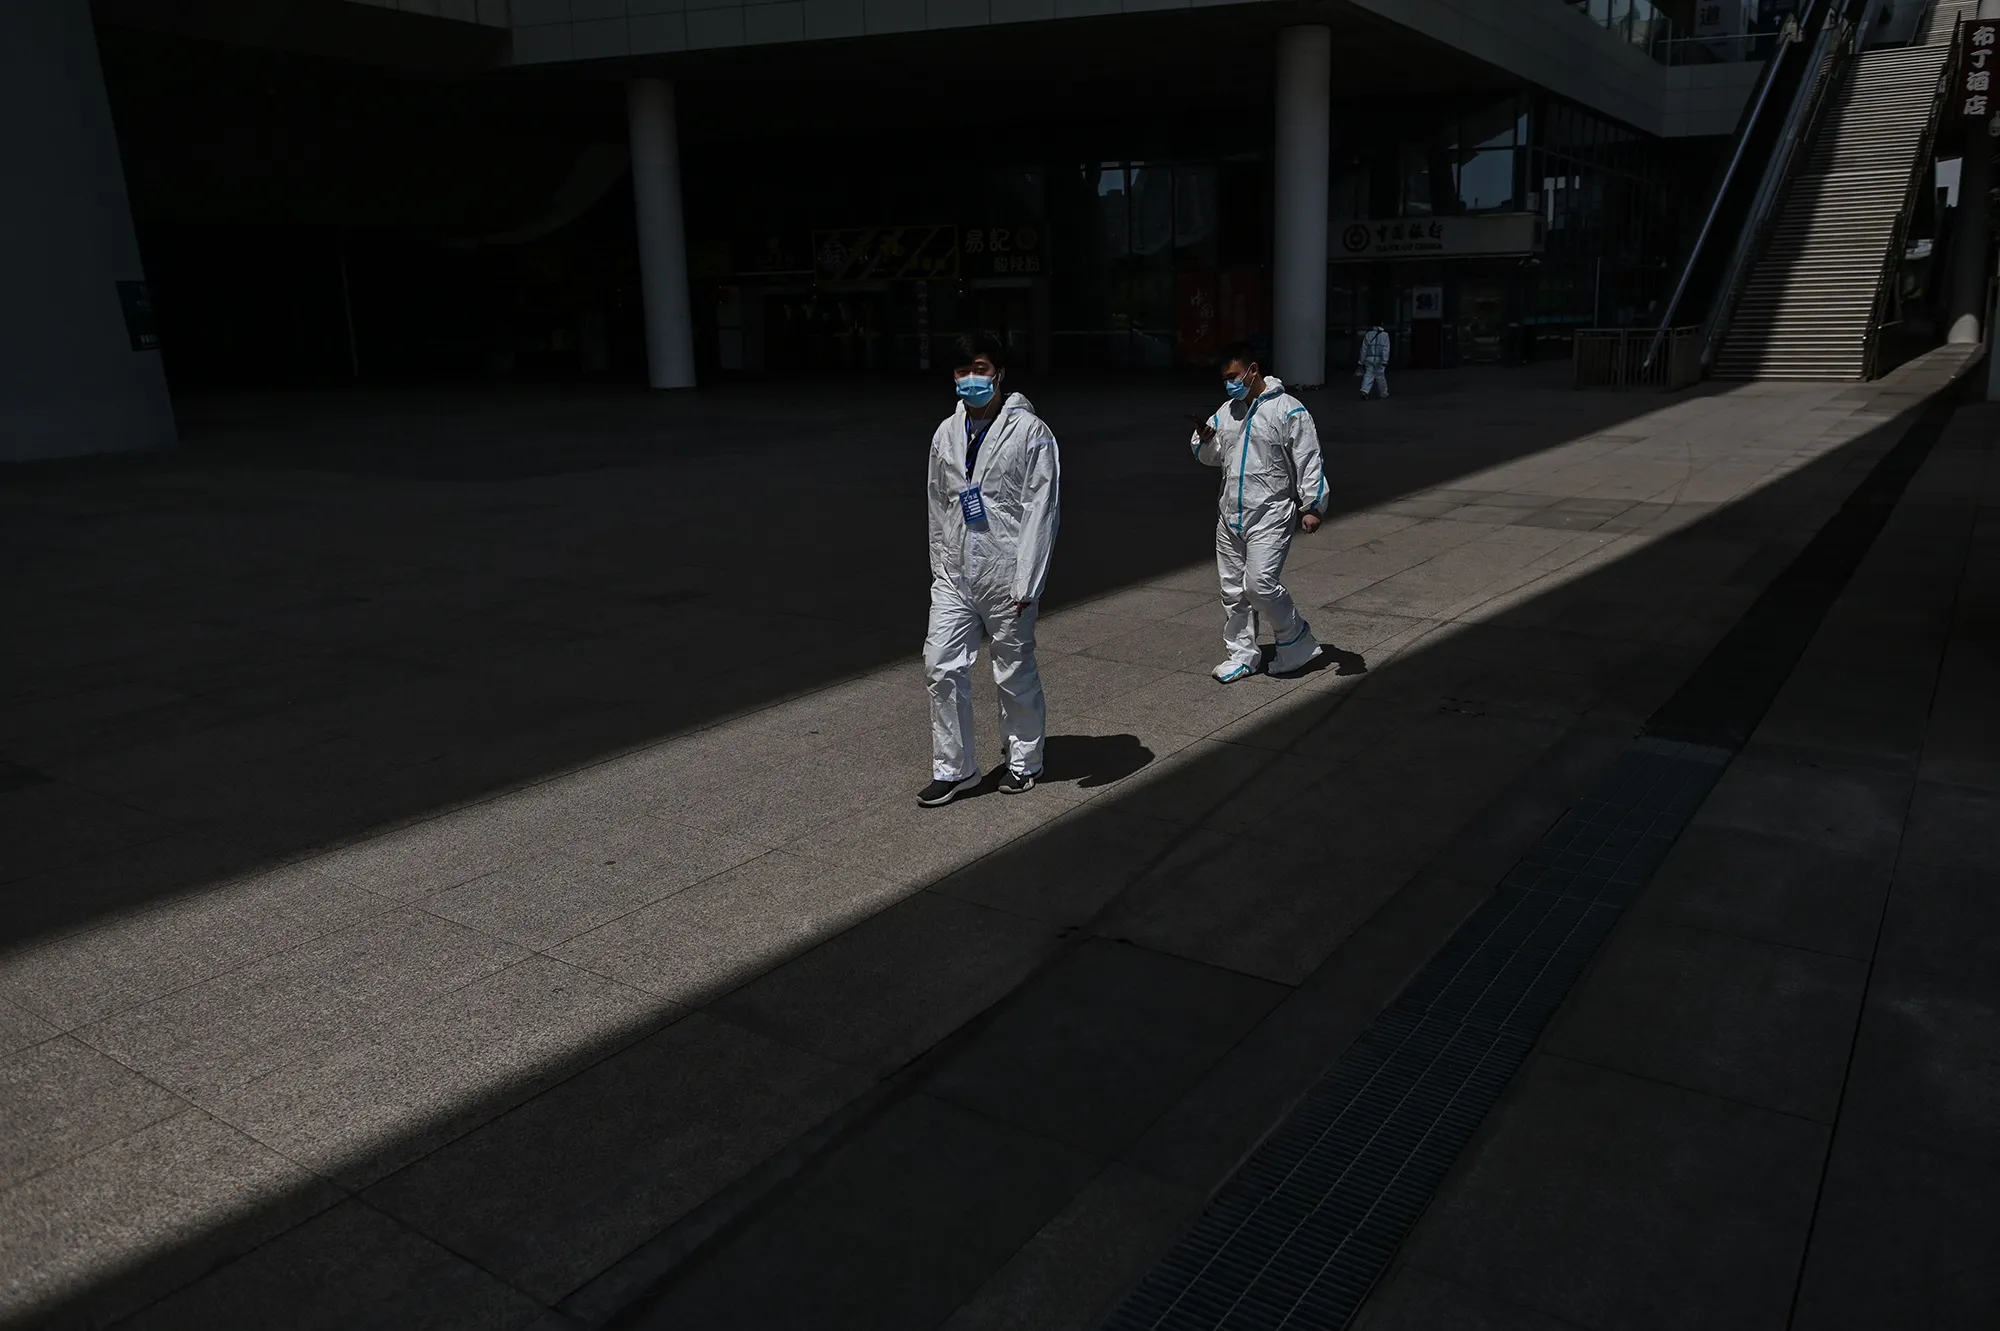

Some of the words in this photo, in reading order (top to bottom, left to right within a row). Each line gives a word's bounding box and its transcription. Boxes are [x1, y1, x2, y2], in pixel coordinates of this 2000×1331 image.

[1963, 26, 1996, 115] 布丁酒店
[965, 228, 1011, 253] 易記
[1374, 220, 1443, 243] 中国银行
[1374, 244, 1400, 253] BANK
[1401, 243, 1413, 251] OF
[1414, 242, 1443, 250] CHINA
